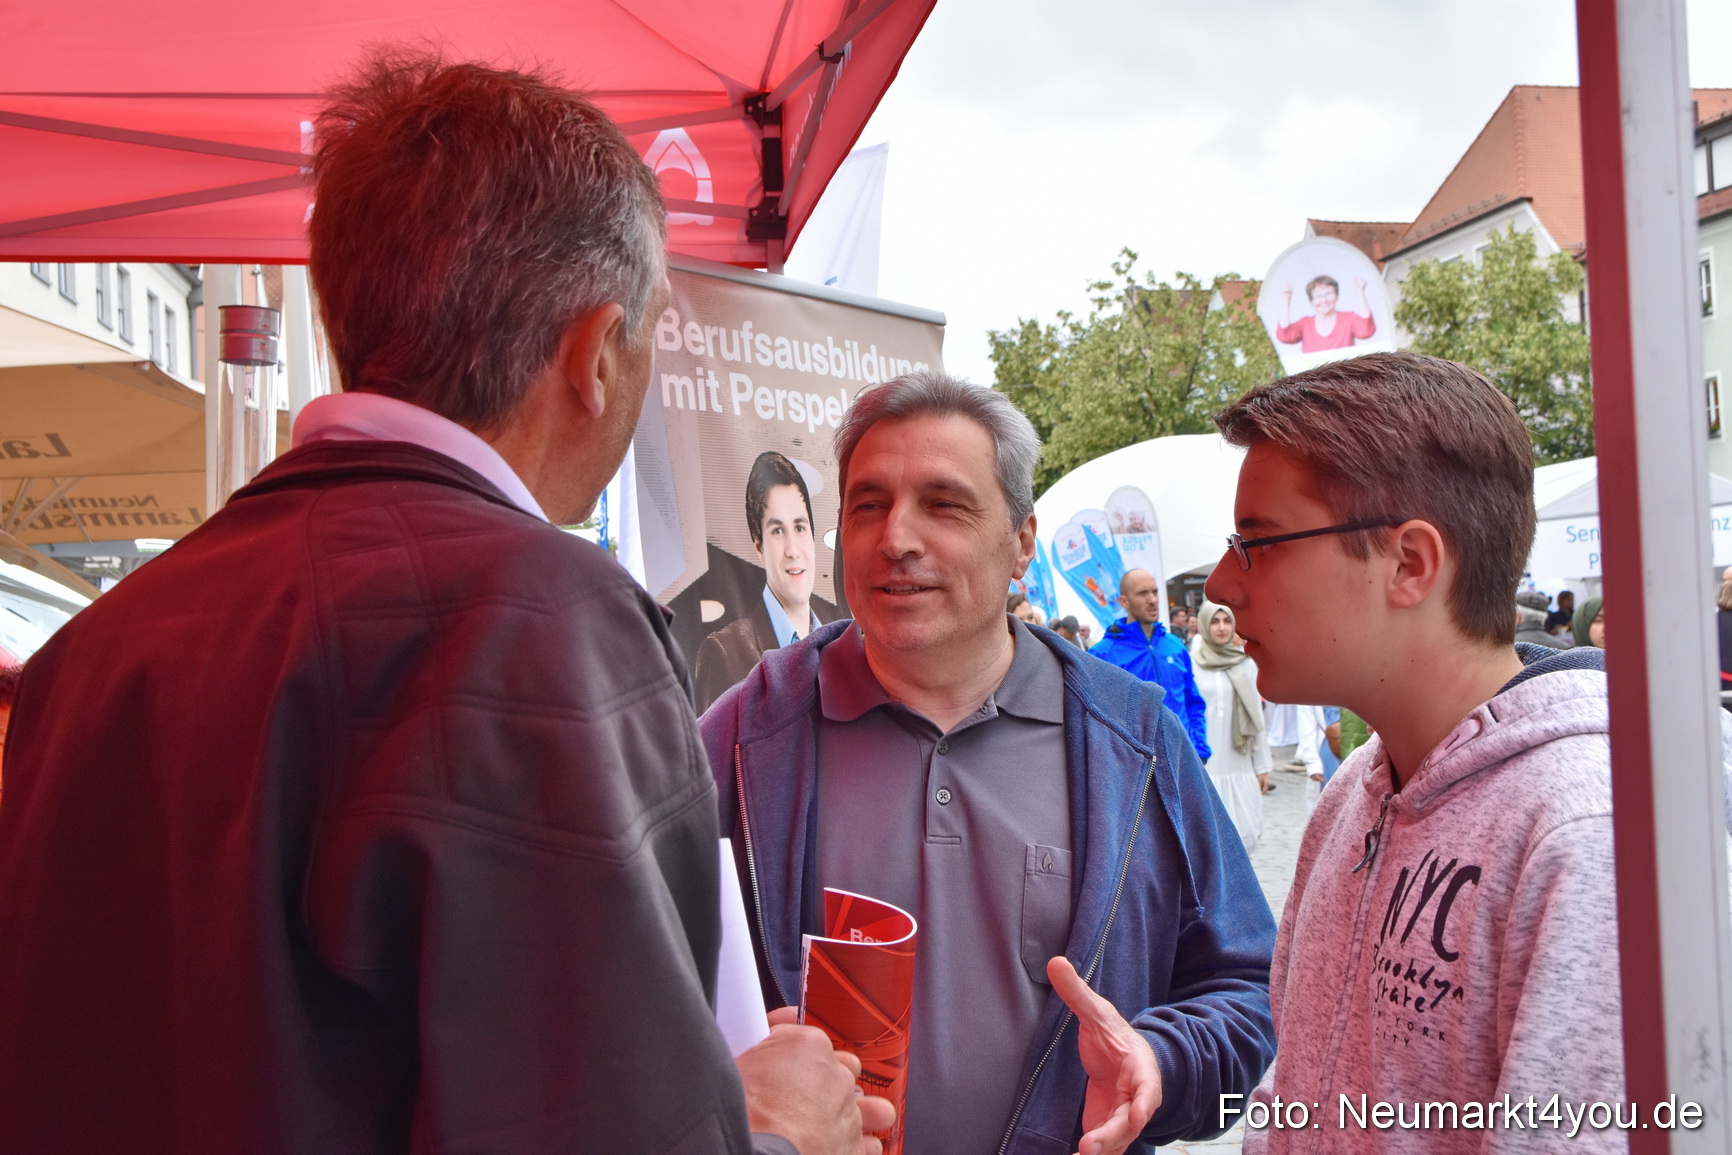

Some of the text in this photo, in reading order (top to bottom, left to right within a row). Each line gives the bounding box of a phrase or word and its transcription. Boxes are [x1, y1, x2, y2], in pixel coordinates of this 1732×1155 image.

[661, 367, 723, 414] mit
[1381, 849, 1482, 962] NYC
[1396, 1017, 1446, 1041] YORK
